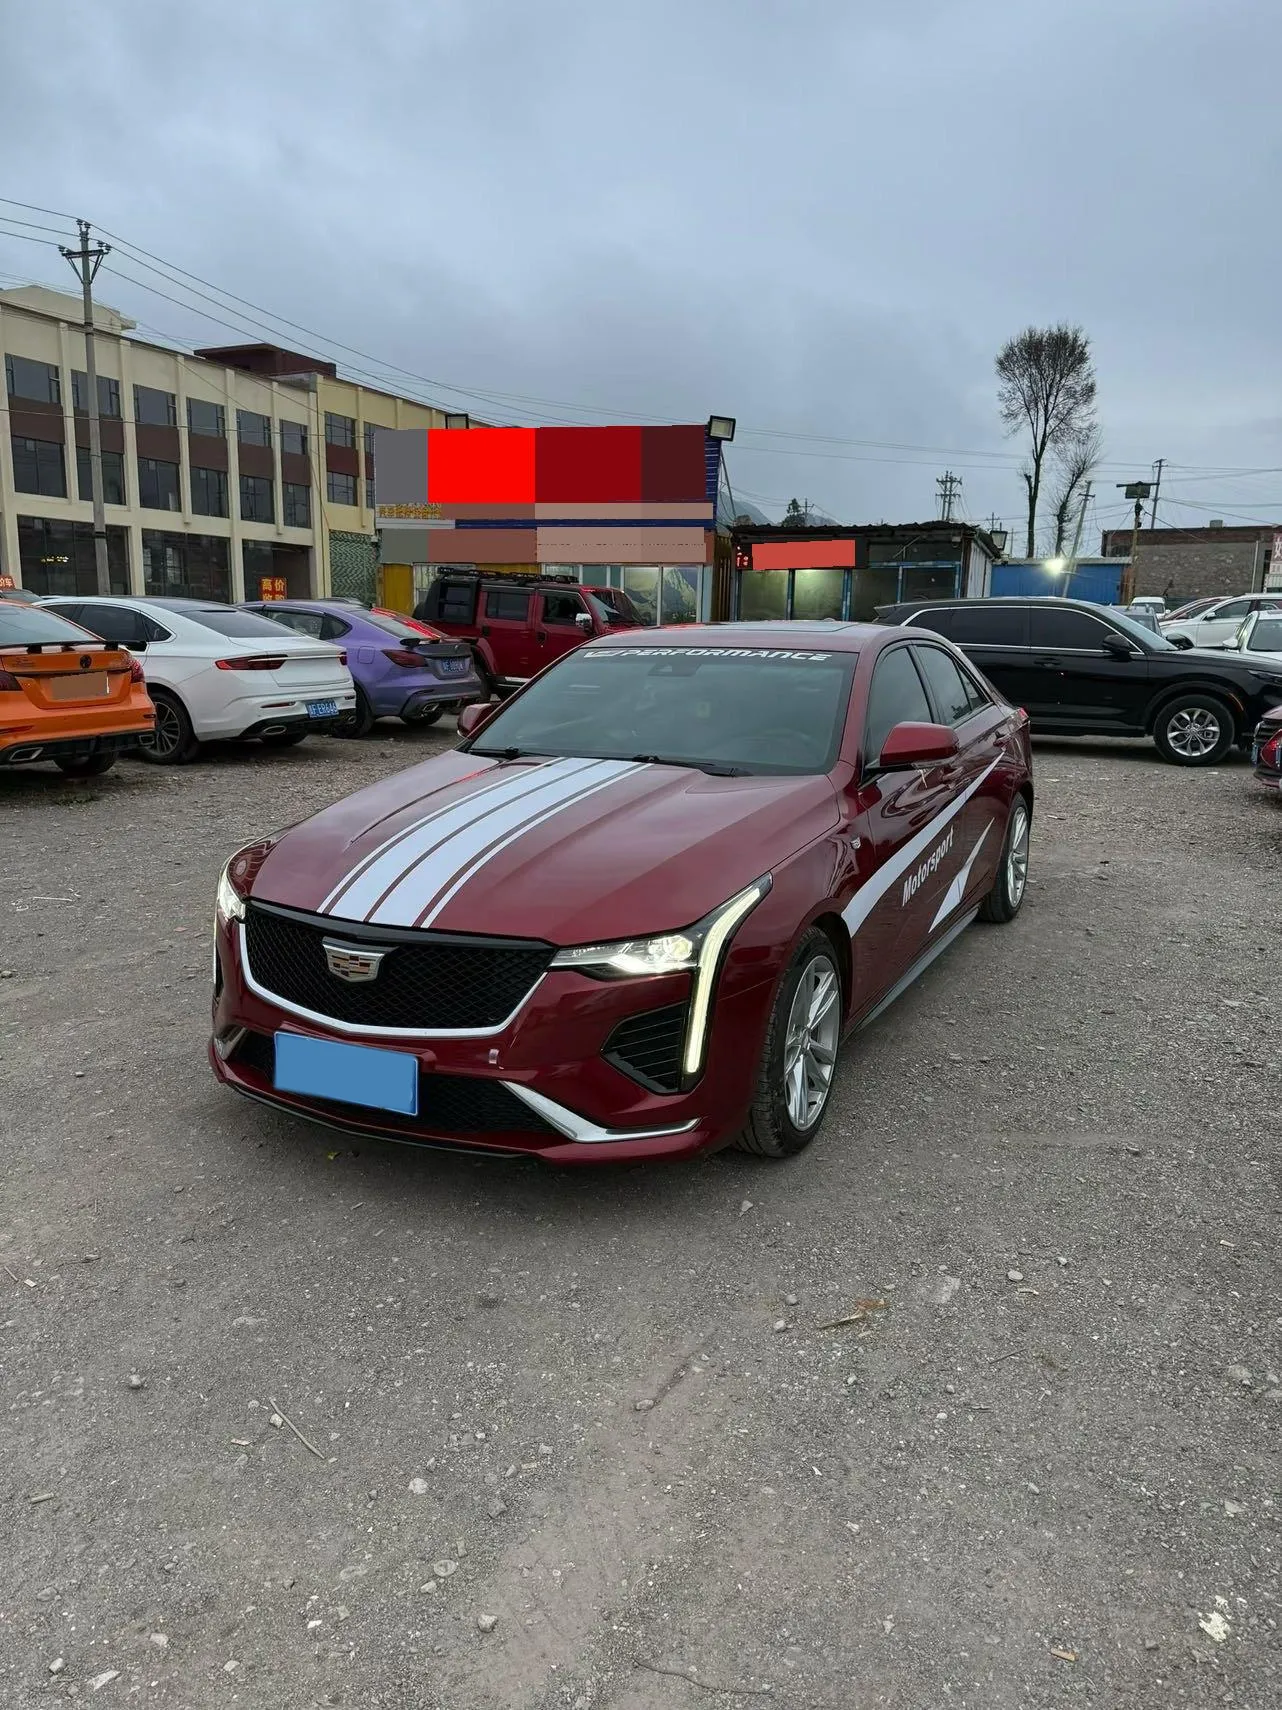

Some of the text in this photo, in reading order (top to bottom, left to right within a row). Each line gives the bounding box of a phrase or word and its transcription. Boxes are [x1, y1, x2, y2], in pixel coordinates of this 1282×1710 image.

[261, 578, 285, 592] 高价
[620, 649, 833, 661] PERFORMANCE
[902, 824, 954, 907] Motorsport
